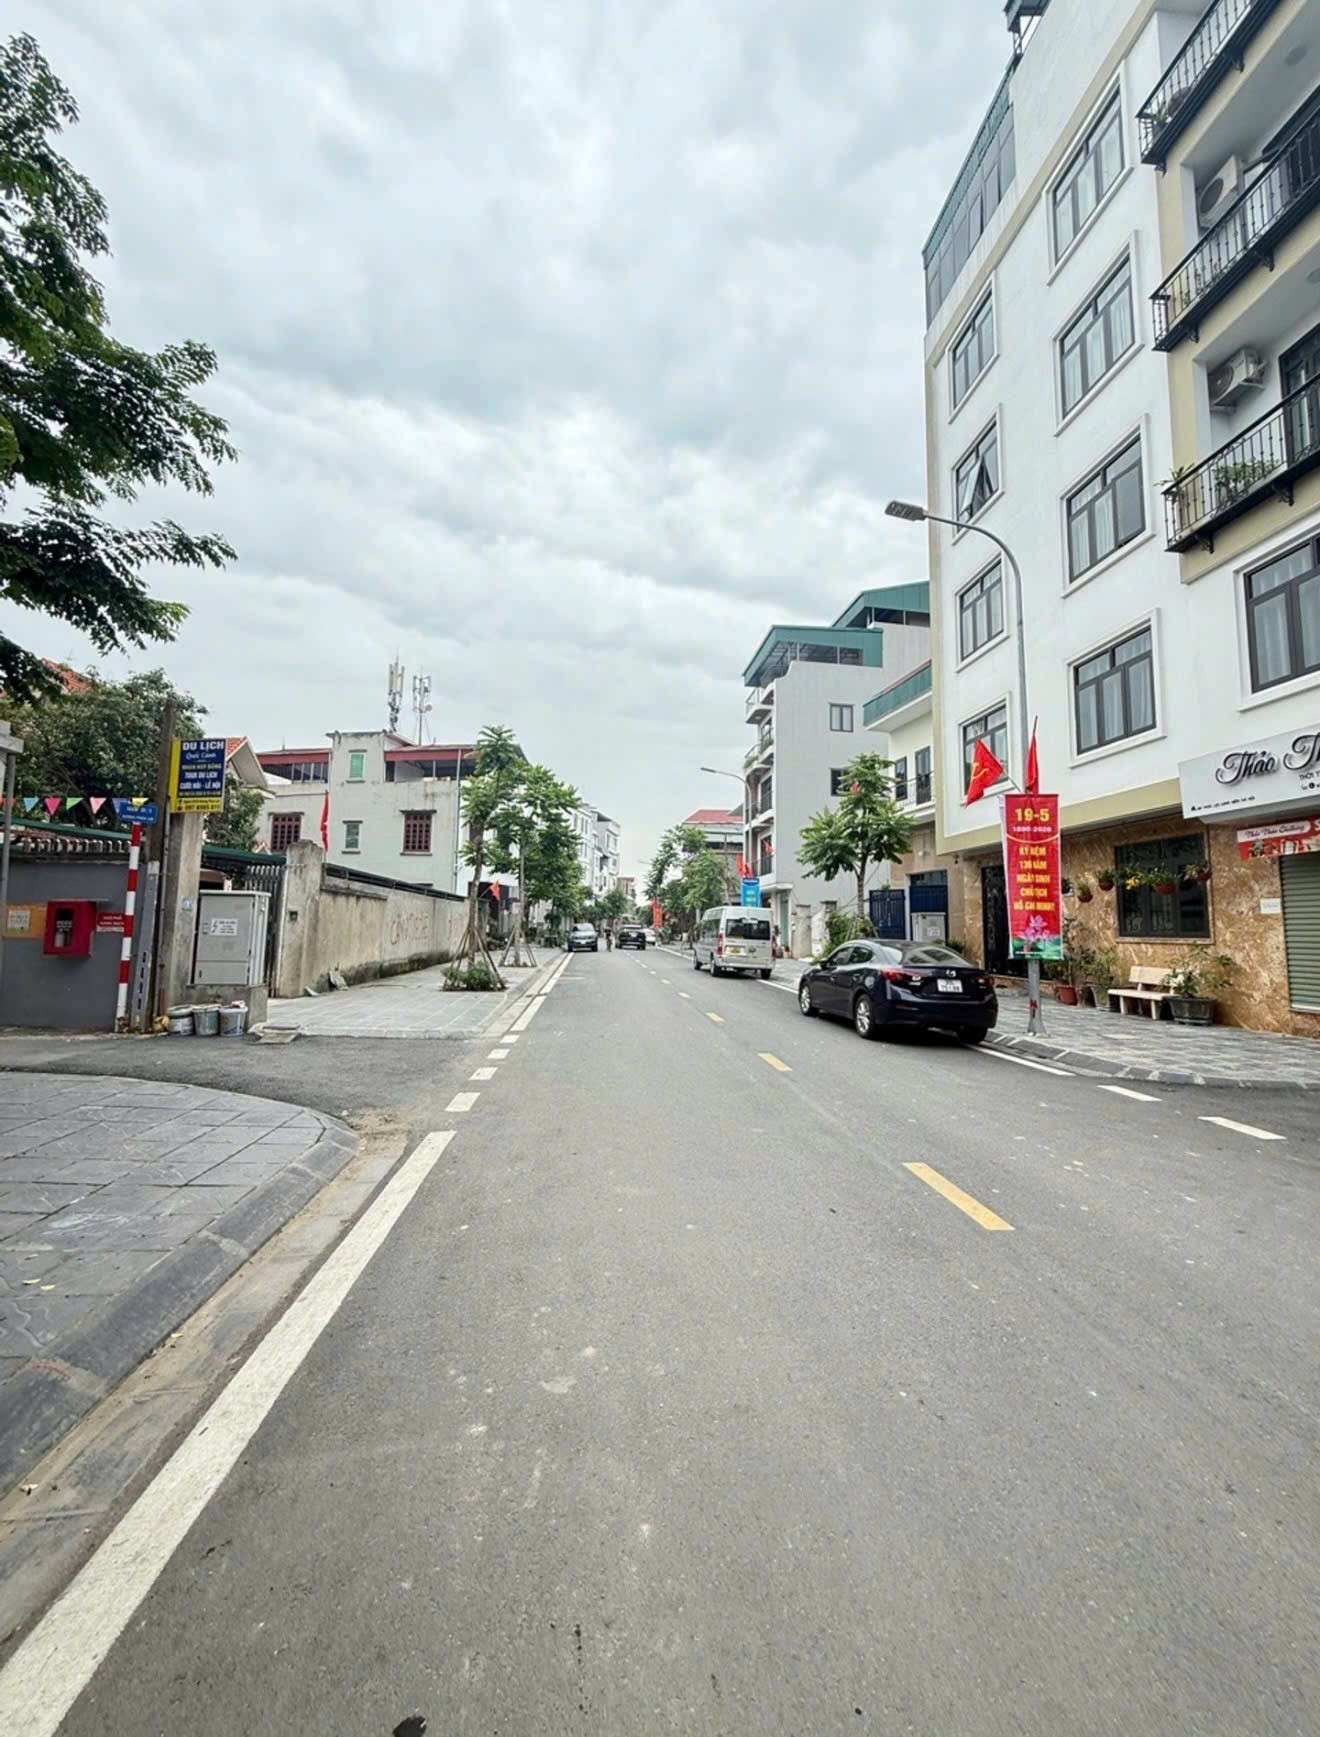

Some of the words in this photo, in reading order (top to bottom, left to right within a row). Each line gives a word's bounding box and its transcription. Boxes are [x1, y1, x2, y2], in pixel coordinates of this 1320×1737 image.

[182, 742, 197, 751] DU
[200, 741, 224, 752] LỊCH
[1215, 750, 1276, 785] Thảo
[1014, 808, 1049, 822] 19-5
